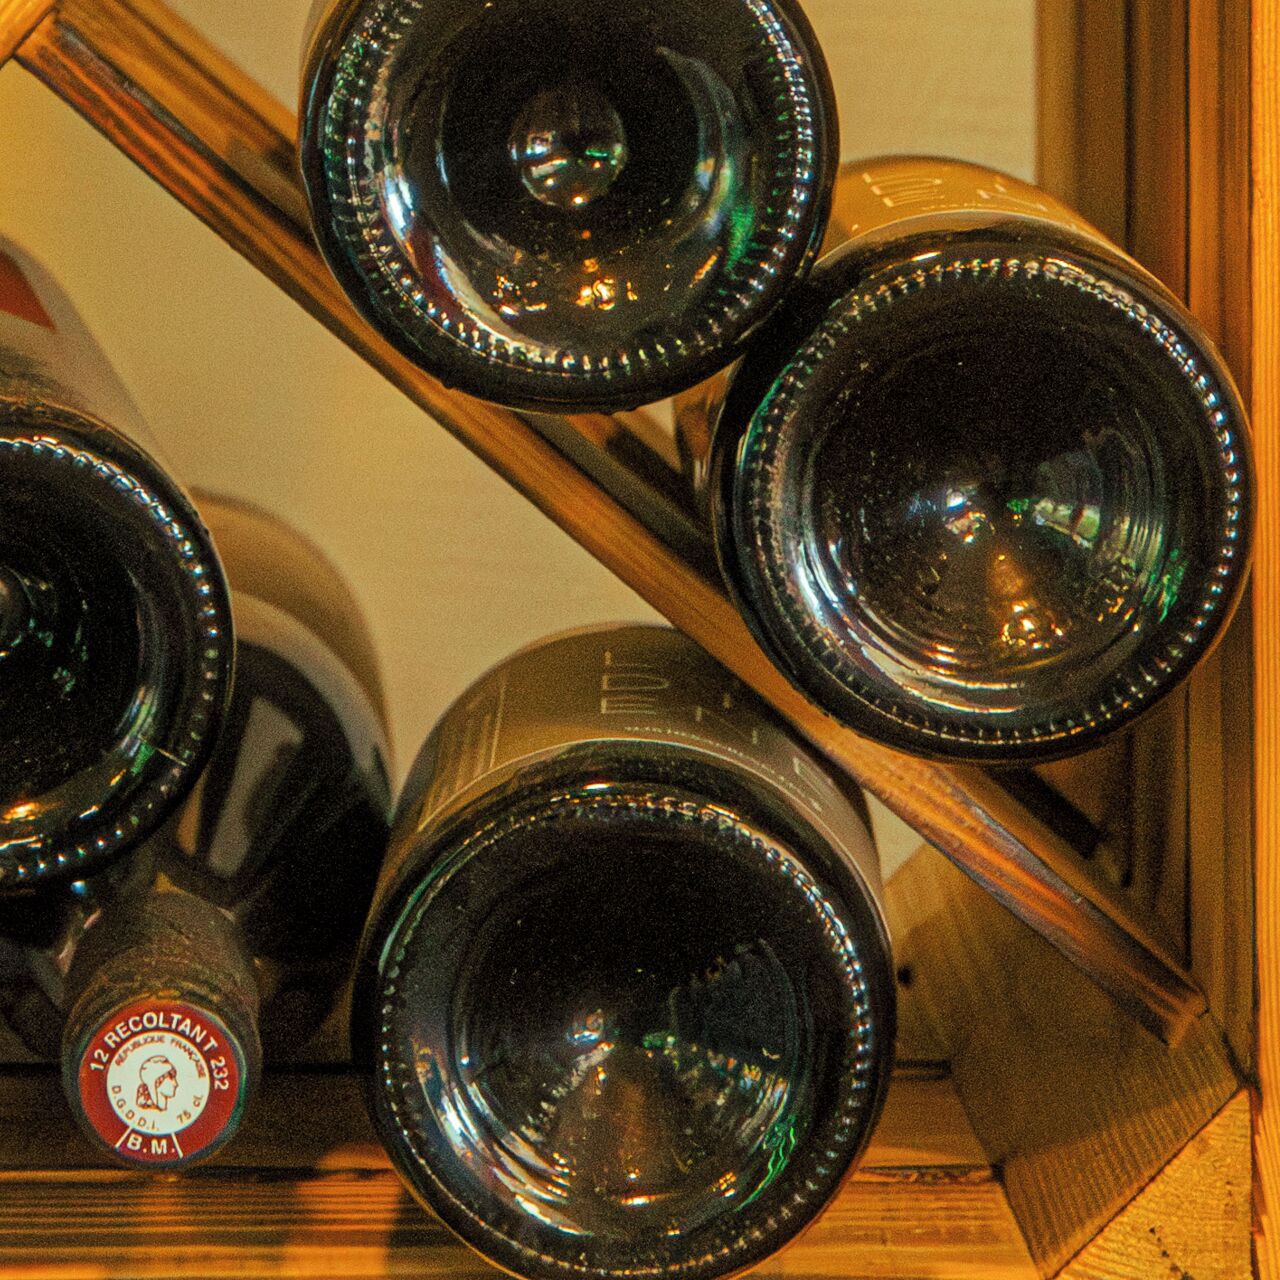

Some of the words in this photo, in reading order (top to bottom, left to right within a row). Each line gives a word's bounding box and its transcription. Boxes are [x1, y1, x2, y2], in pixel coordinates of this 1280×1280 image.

[89, 1048, 110, 1073] 12
[104, 1011, 219, 1053] RECOLTANT
[210, 1056, 230, 1091] 232
[126, 1132, 176, 1156] B.M.
